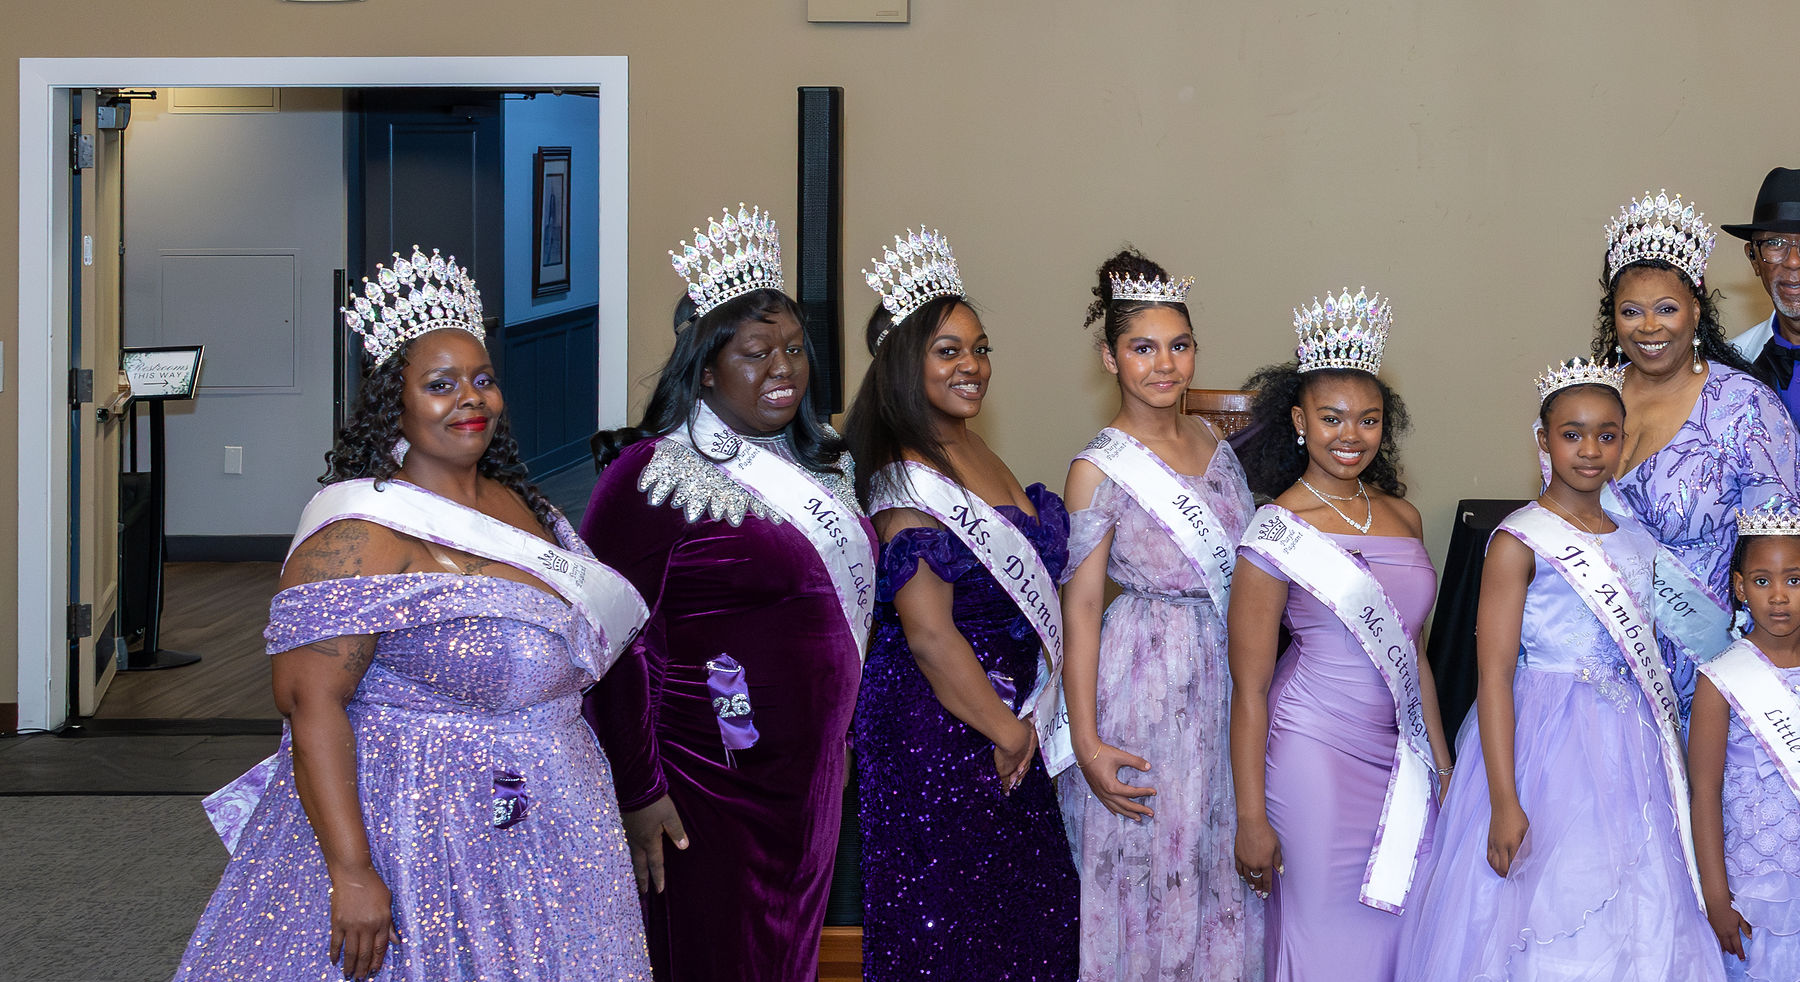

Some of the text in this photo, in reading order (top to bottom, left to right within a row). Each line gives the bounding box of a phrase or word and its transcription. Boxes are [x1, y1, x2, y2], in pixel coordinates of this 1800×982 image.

[133, 362, 188, 371] Restrooms
[134, 371, 182, 380] THIS WAY
[950, 505, 991, 554] Ms.
[1172, 494, 1234, 592] Miss. Pur
[804, 498, 871, 609] Miss. Lake
[1556, 546, 1590, 578] Jr.
[1653, 572, 1697, 617] ector
[1359, 606, 1385, 643] Ms.
[1387, 645, 1415, 698] Citrus
[713, 693, 752, 718] 26
[1043, 705, 1070, 743] 2026
